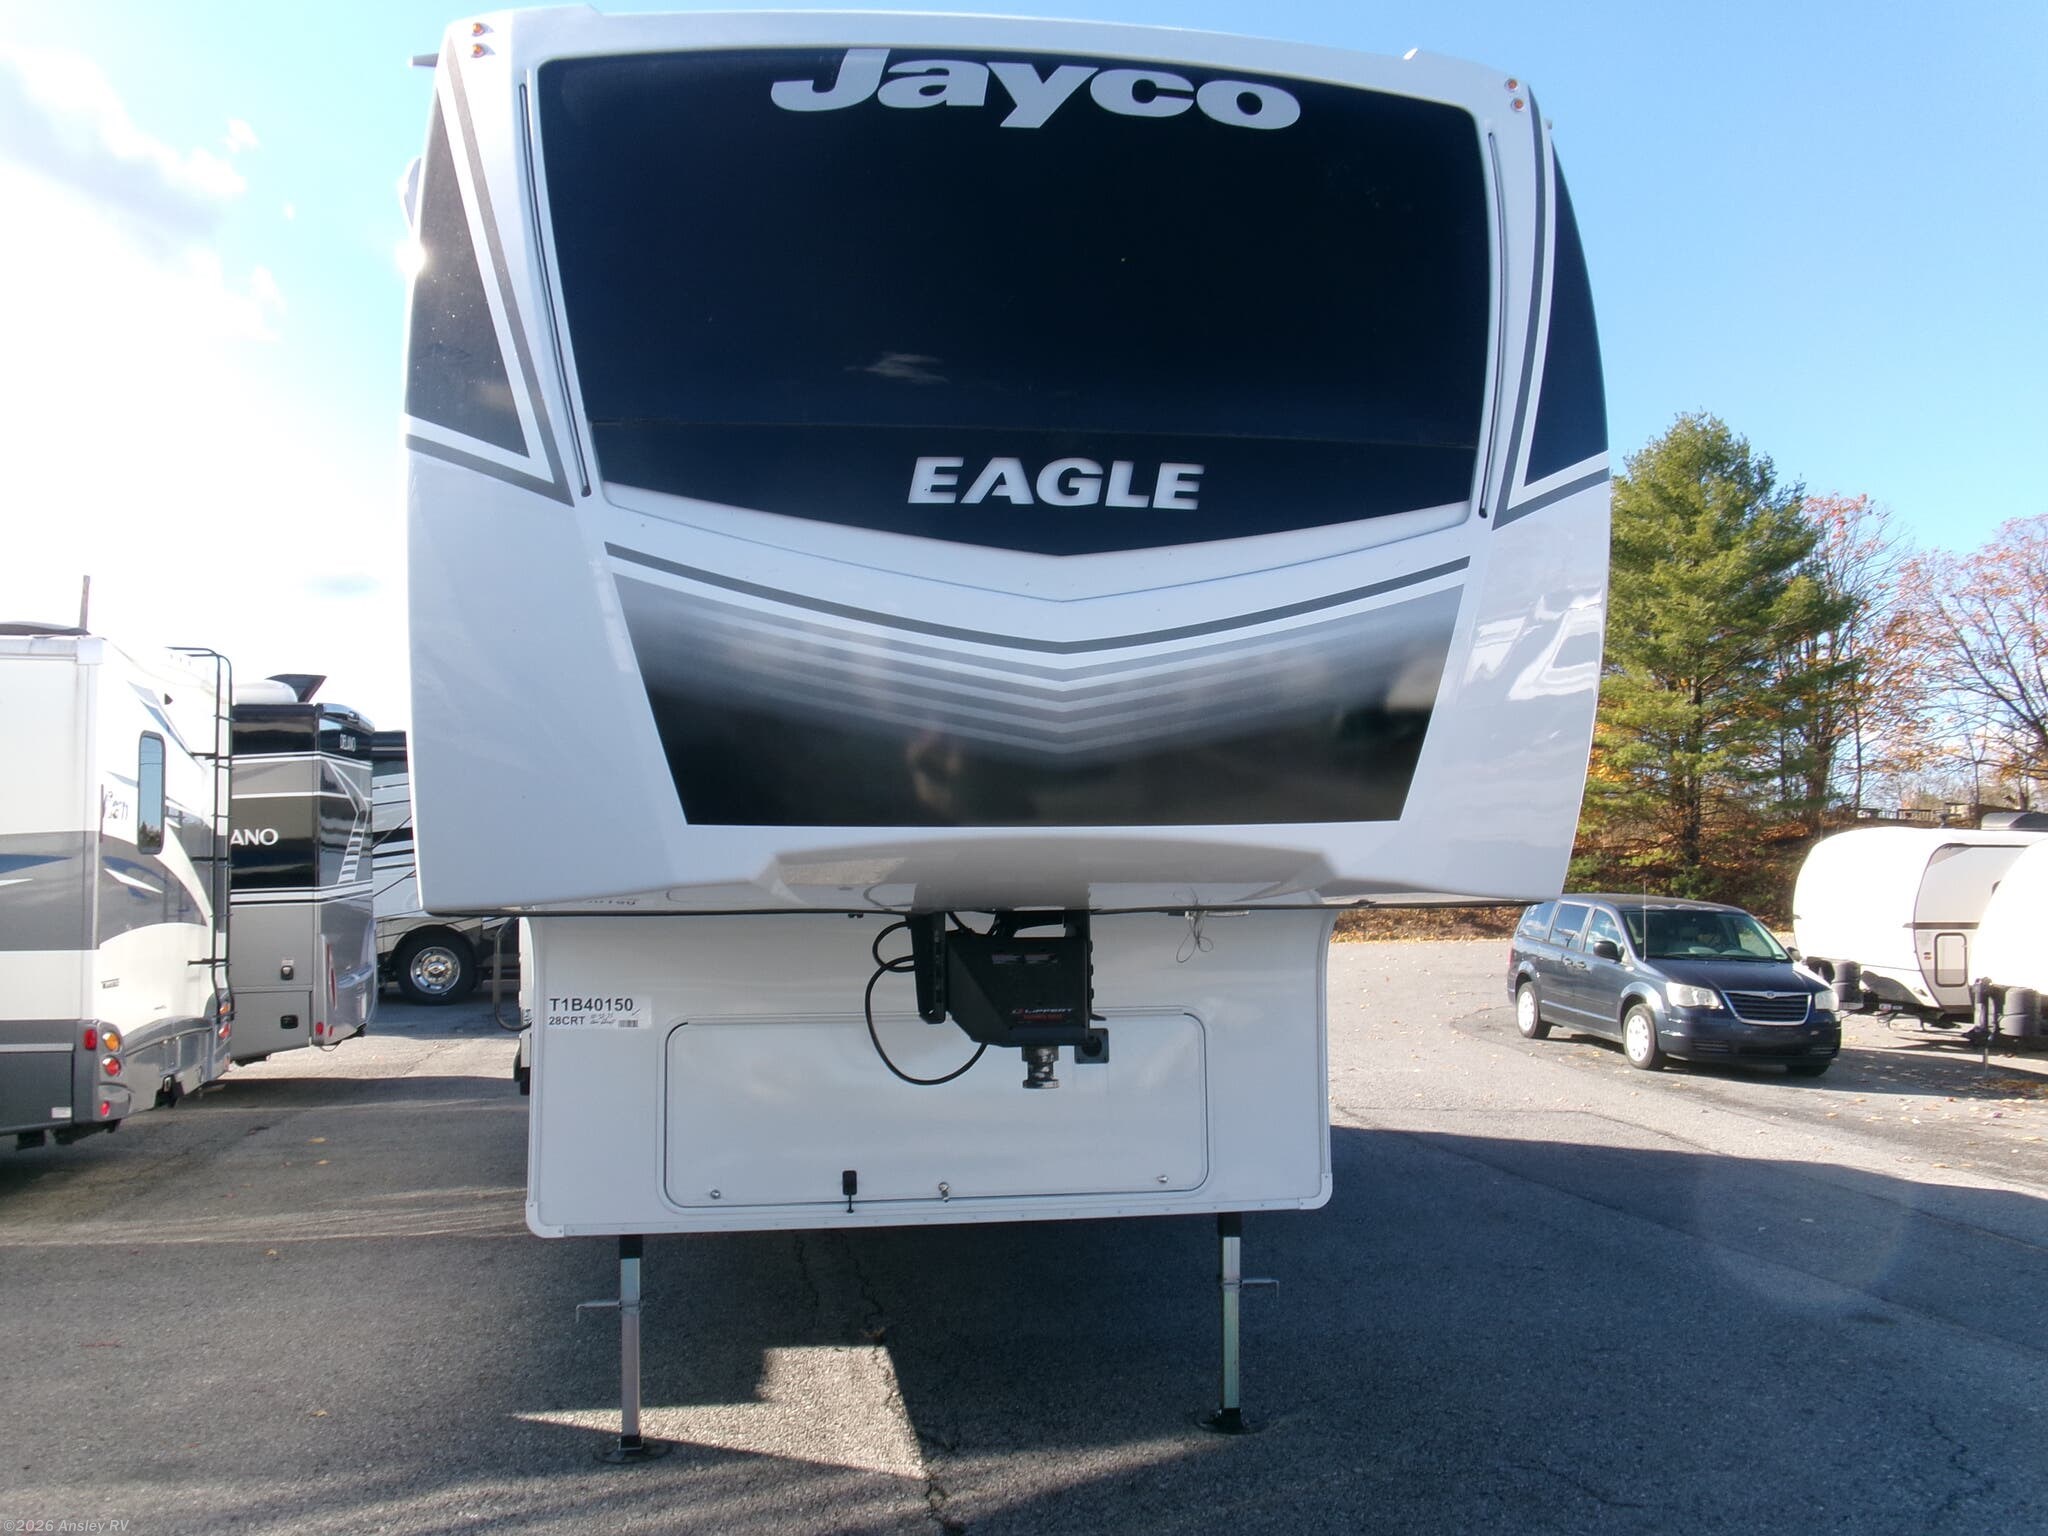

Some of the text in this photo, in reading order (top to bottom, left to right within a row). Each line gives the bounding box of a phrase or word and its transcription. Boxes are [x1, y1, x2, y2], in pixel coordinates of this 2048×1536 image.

[770, 48, 1300, 129] Jayco
[907, 456, 1205, 511] EAGLE
[548, 1016, 586, 1026] 28CRT
[549, 998, 633, 1012] T1B40150
